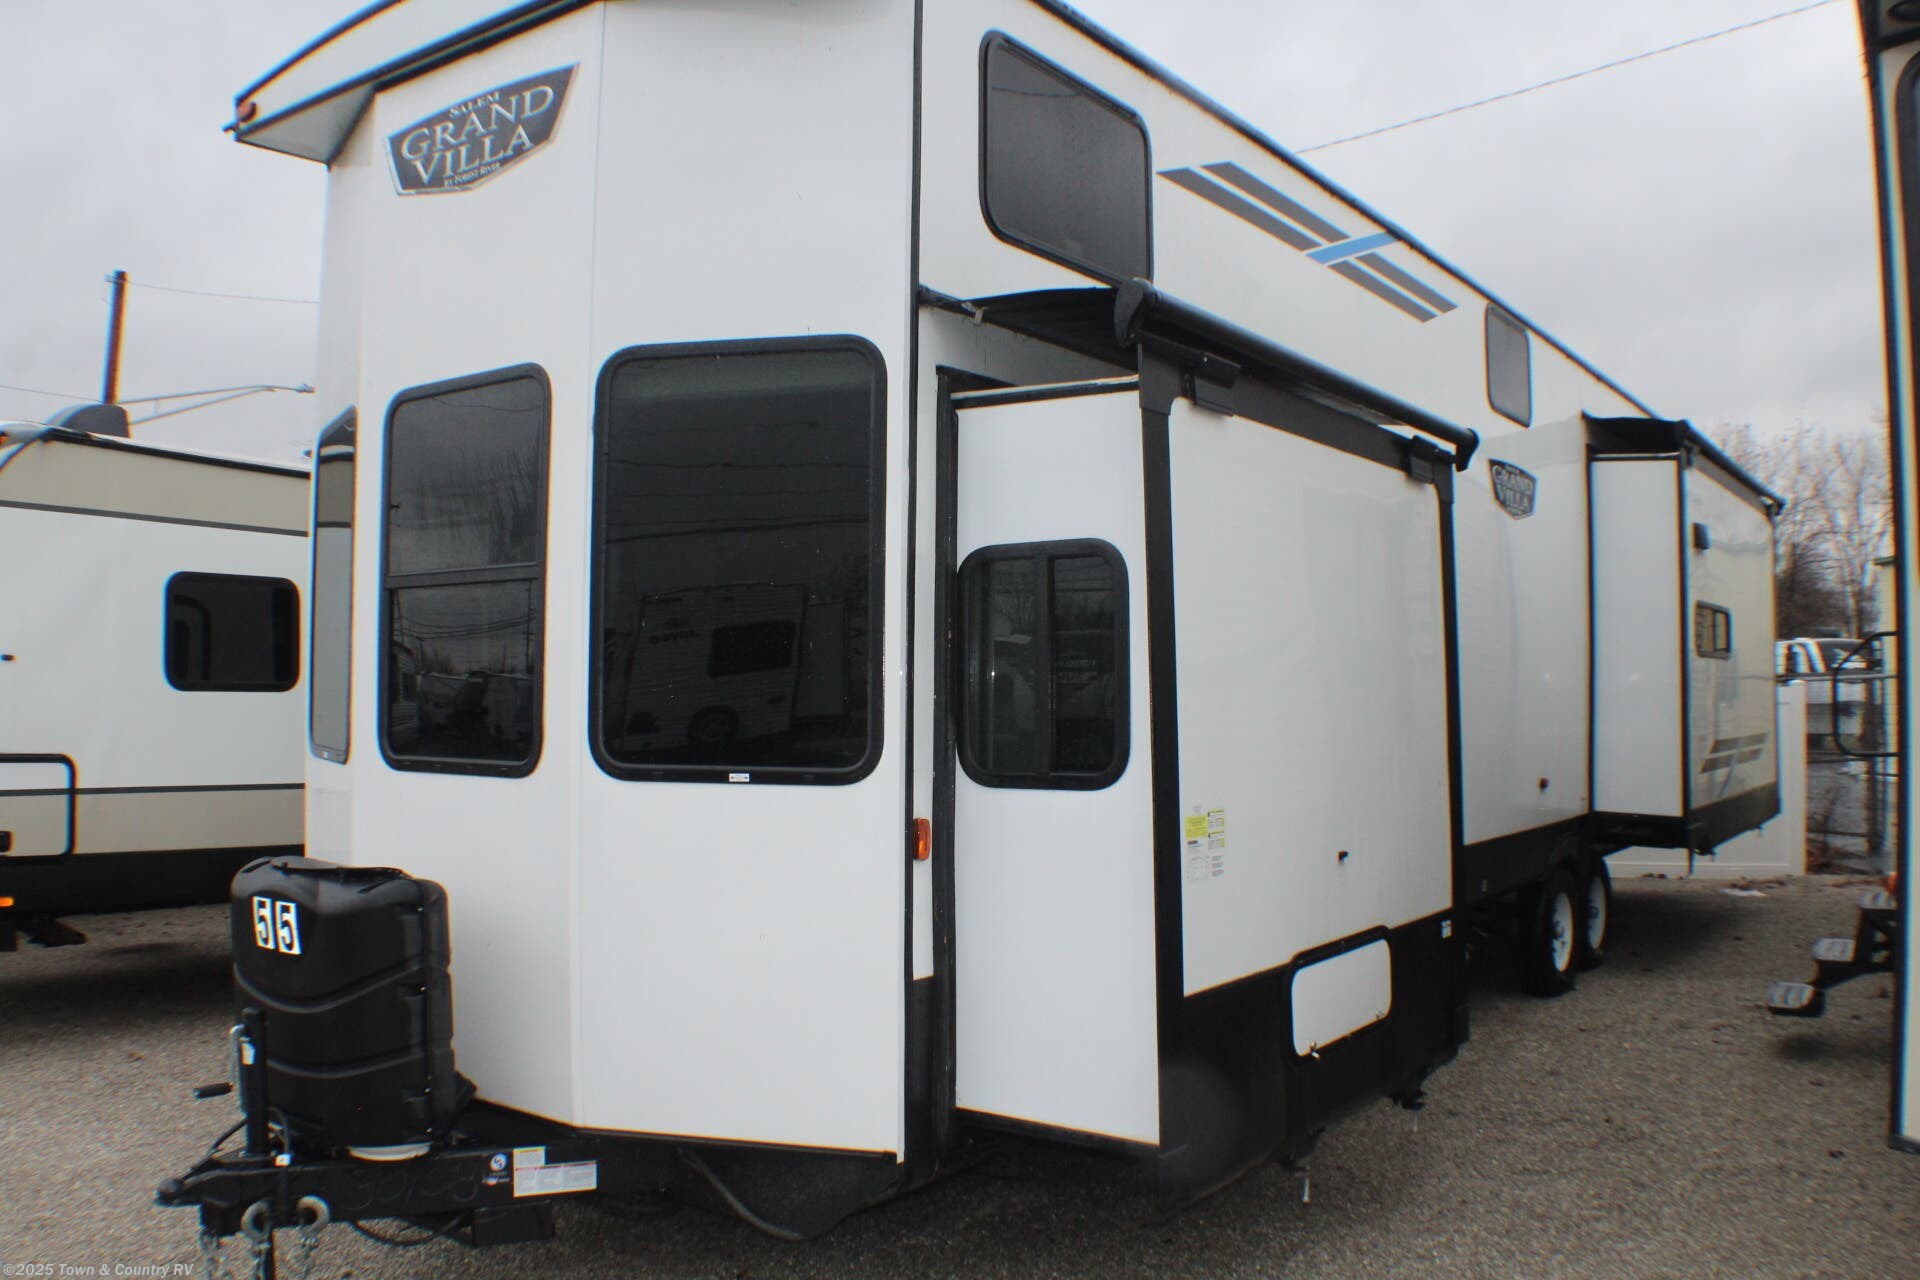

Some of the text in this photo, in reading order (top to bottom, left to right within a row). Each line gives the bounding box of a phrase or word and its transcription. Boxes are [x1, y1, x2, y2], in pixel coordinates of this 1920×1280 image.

[401, 85, 555, 161] GRAND
[411, 124, 536, 185] VILLA
[1491, 465, 1533, 495] GRAND
[1496, 484, 1530, 508] VILLA
[256, 899, 295, 952] 55
